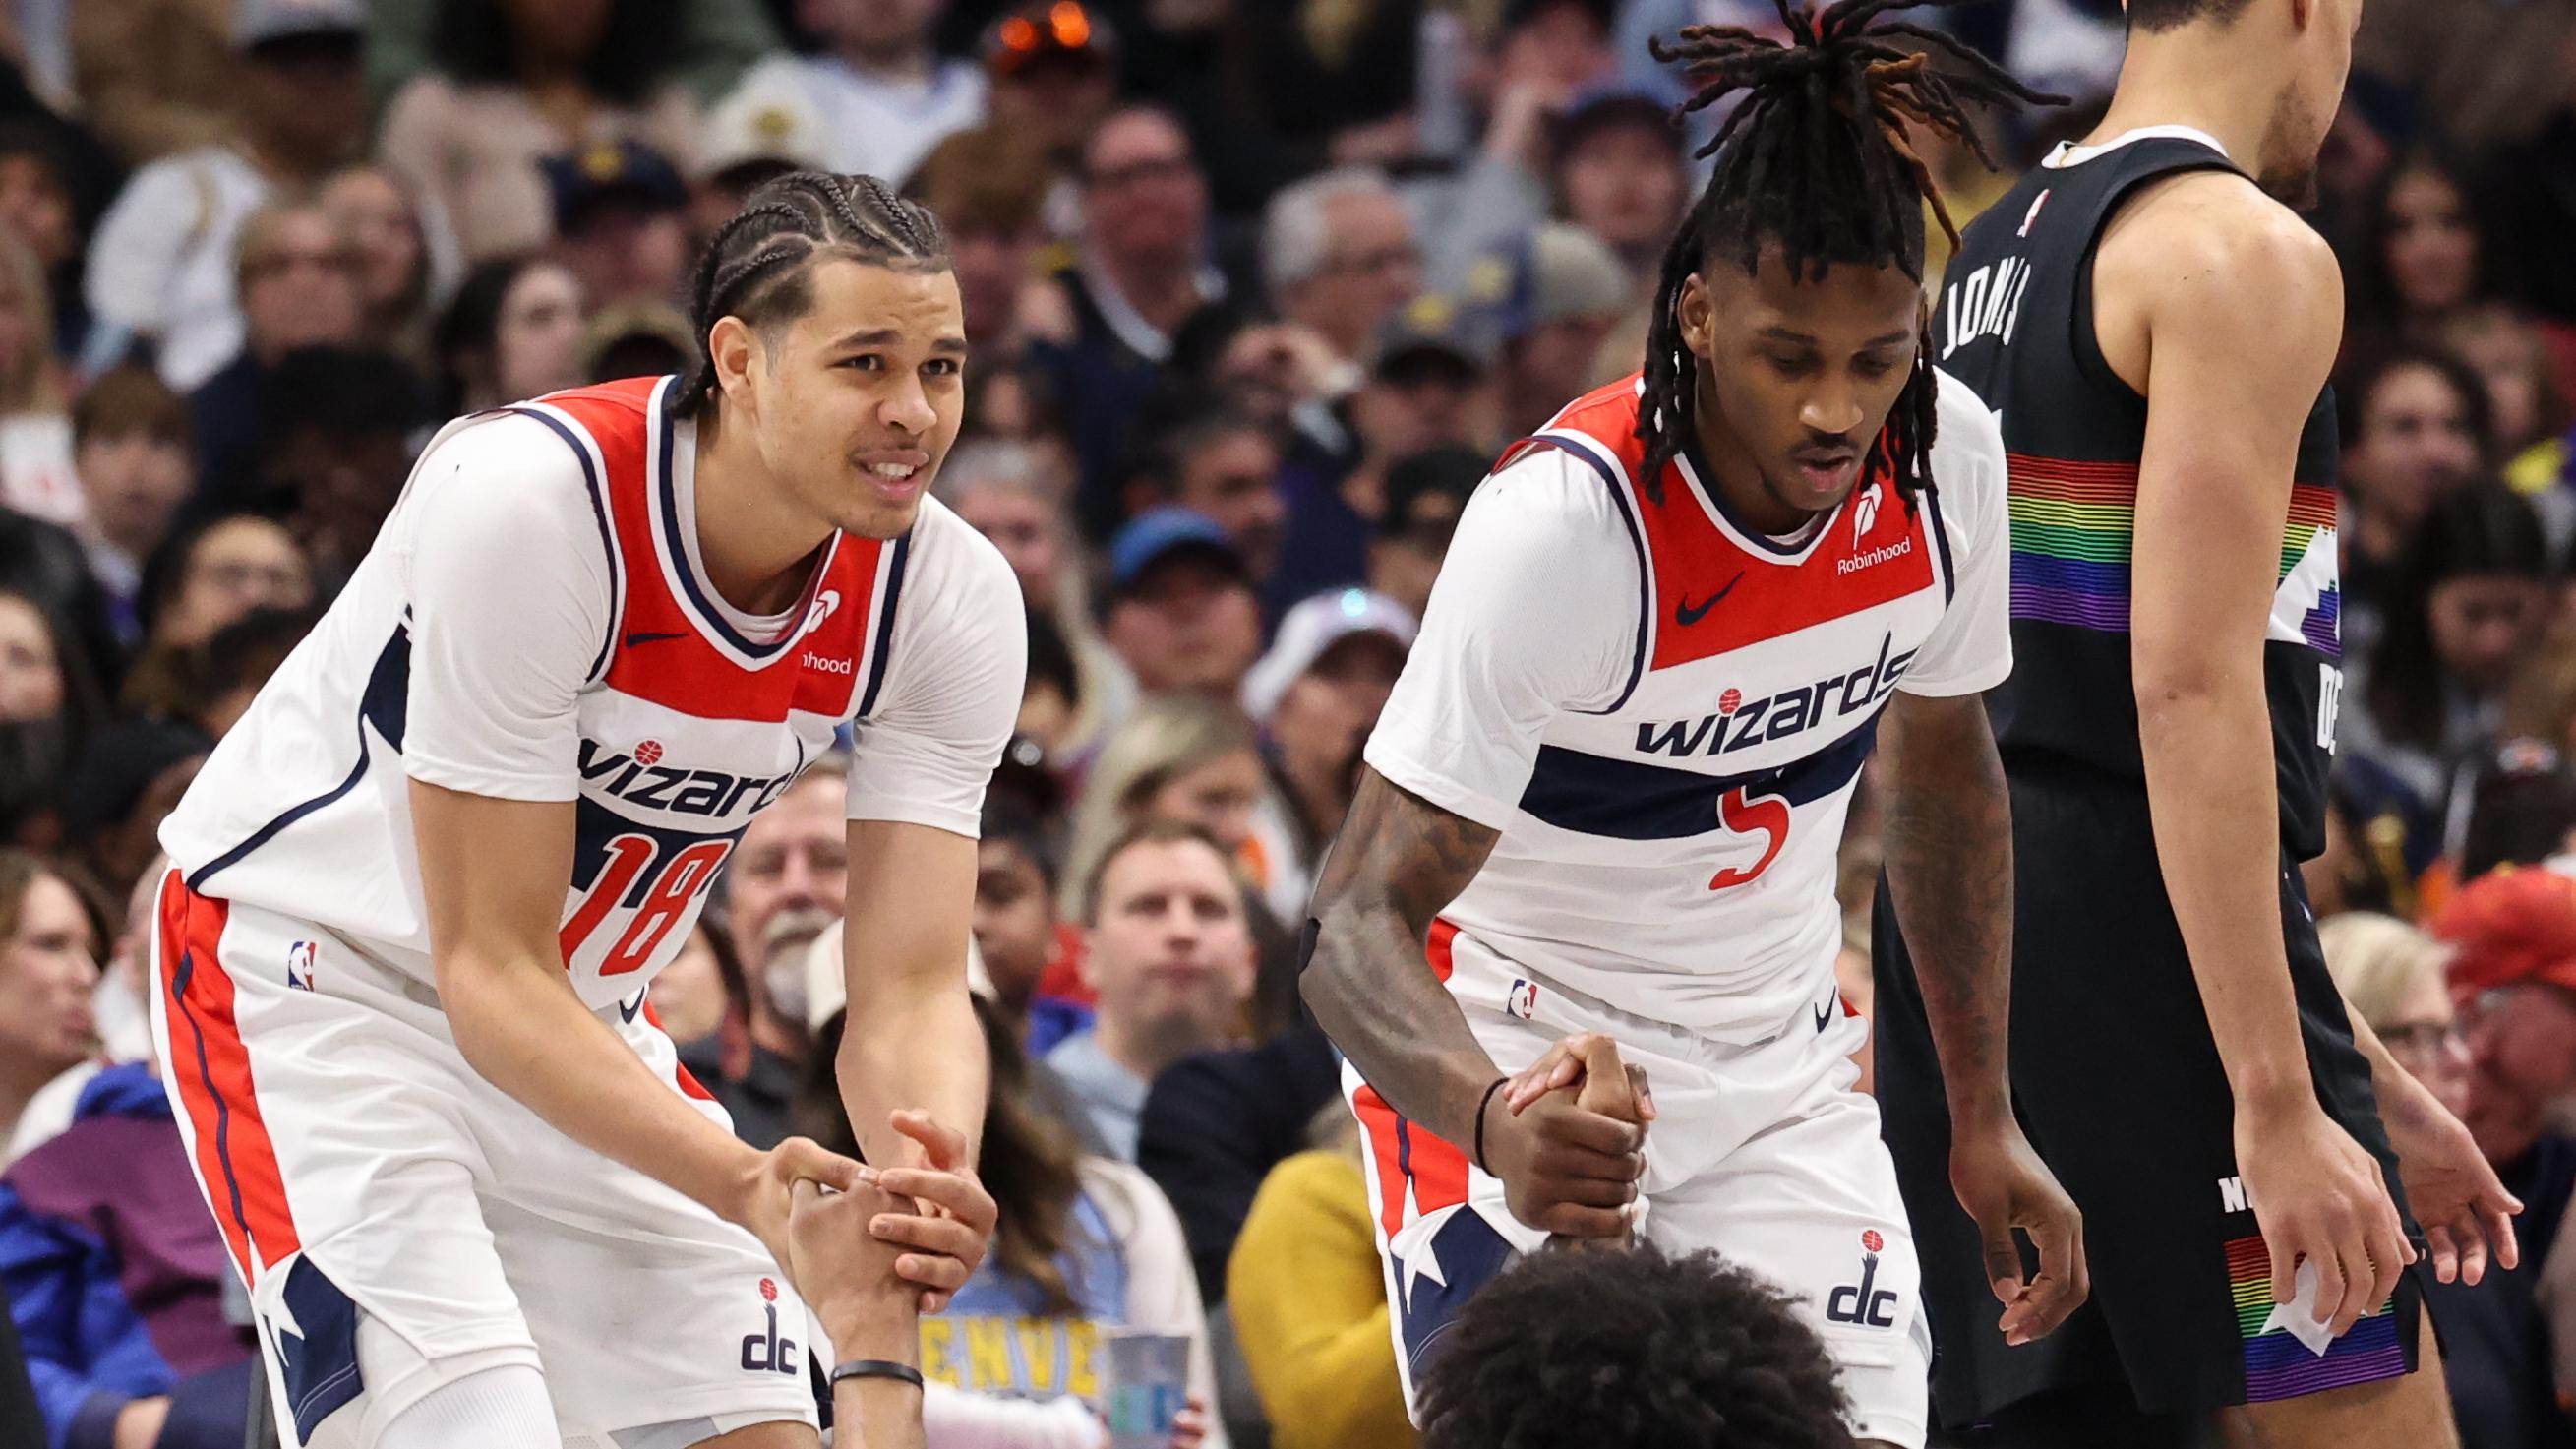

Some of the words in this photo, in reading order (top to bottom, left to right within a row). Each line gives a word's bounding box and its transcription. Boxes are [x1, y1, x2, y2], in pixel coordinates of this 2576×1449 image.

[1837, 535, 1911, 576] Robinhood
[1635, 630, 1920, 757] wizards
[1708, 785, 1790, 891] 5
[559, 833, 735, 977] 18
[1827, 1251, 1897, 1328] dc
[741, 1301, 797, 1376] dc
[919, 1315, 1100, 1397] ENVE
